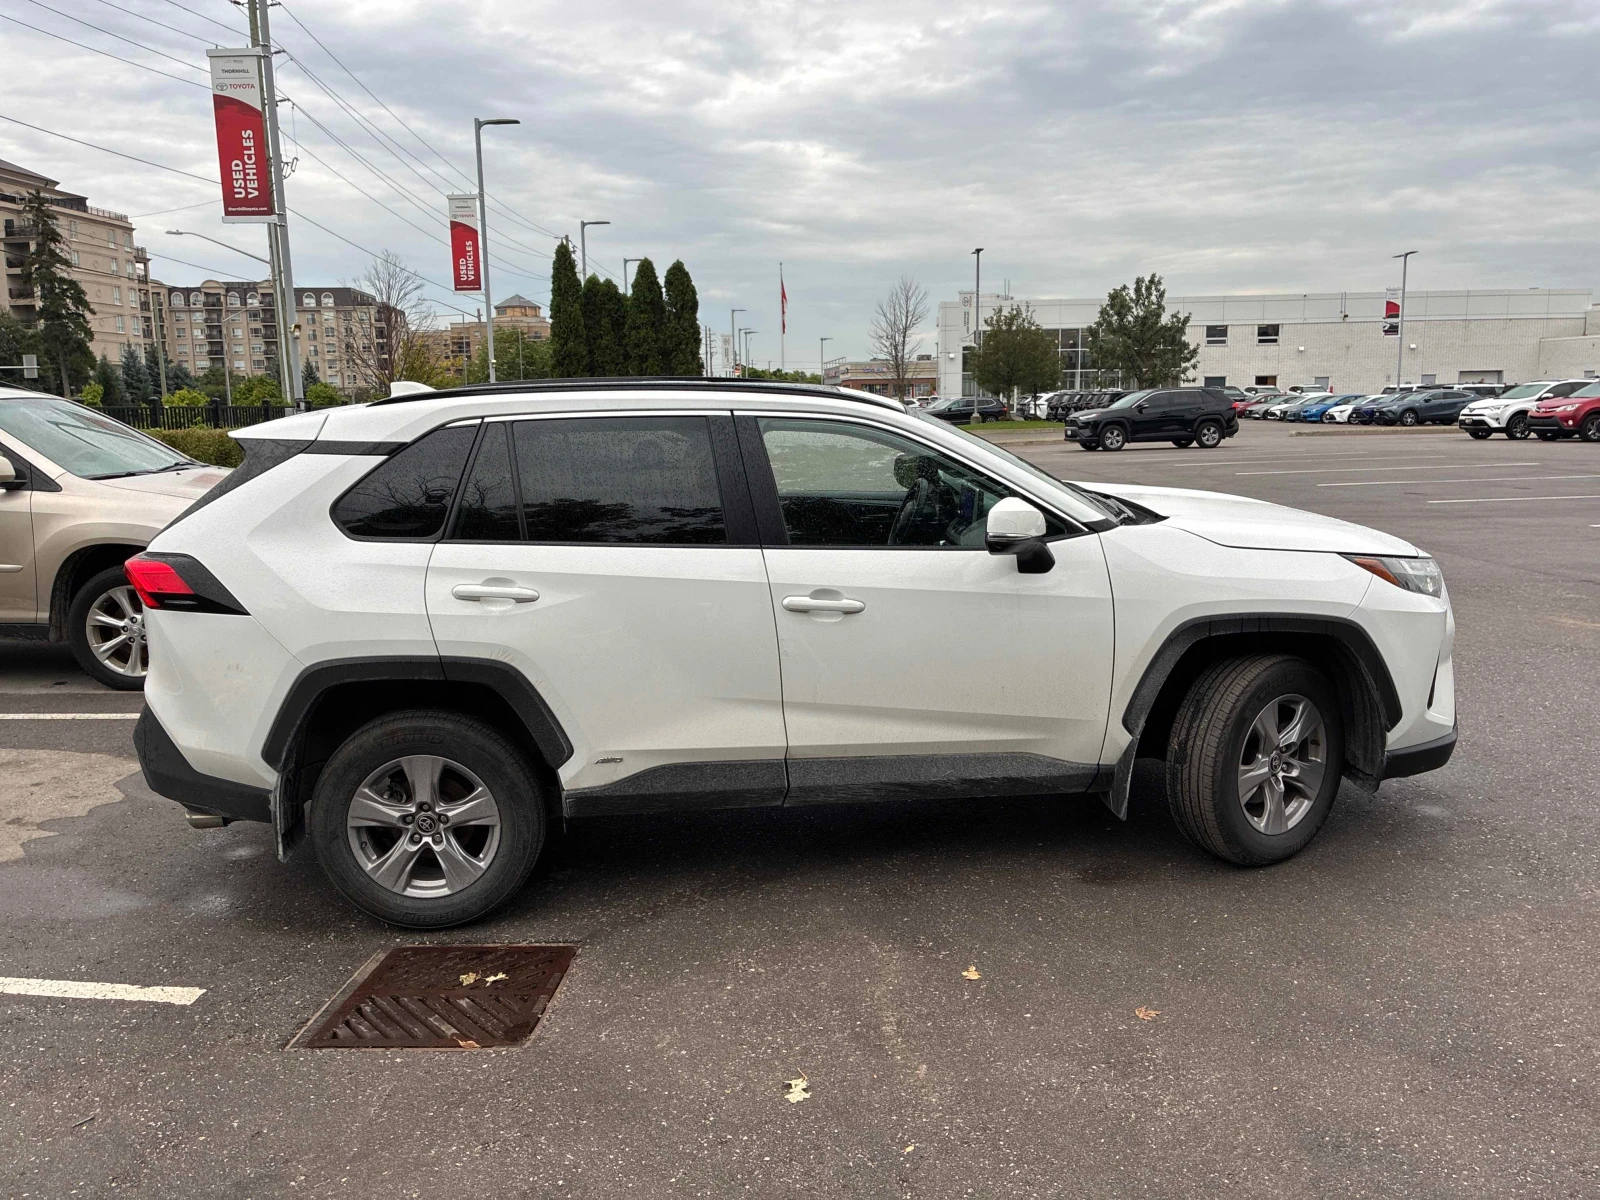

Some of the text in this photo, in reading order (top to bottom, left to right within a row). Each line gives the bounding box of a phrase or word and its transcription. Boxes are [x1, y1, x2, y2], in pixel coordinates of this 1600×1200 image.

[231, 159, 245, 198] USED
[241, 129, 258, 199] VEHICLES
[466, 240, 474, 280] VEHICLES
